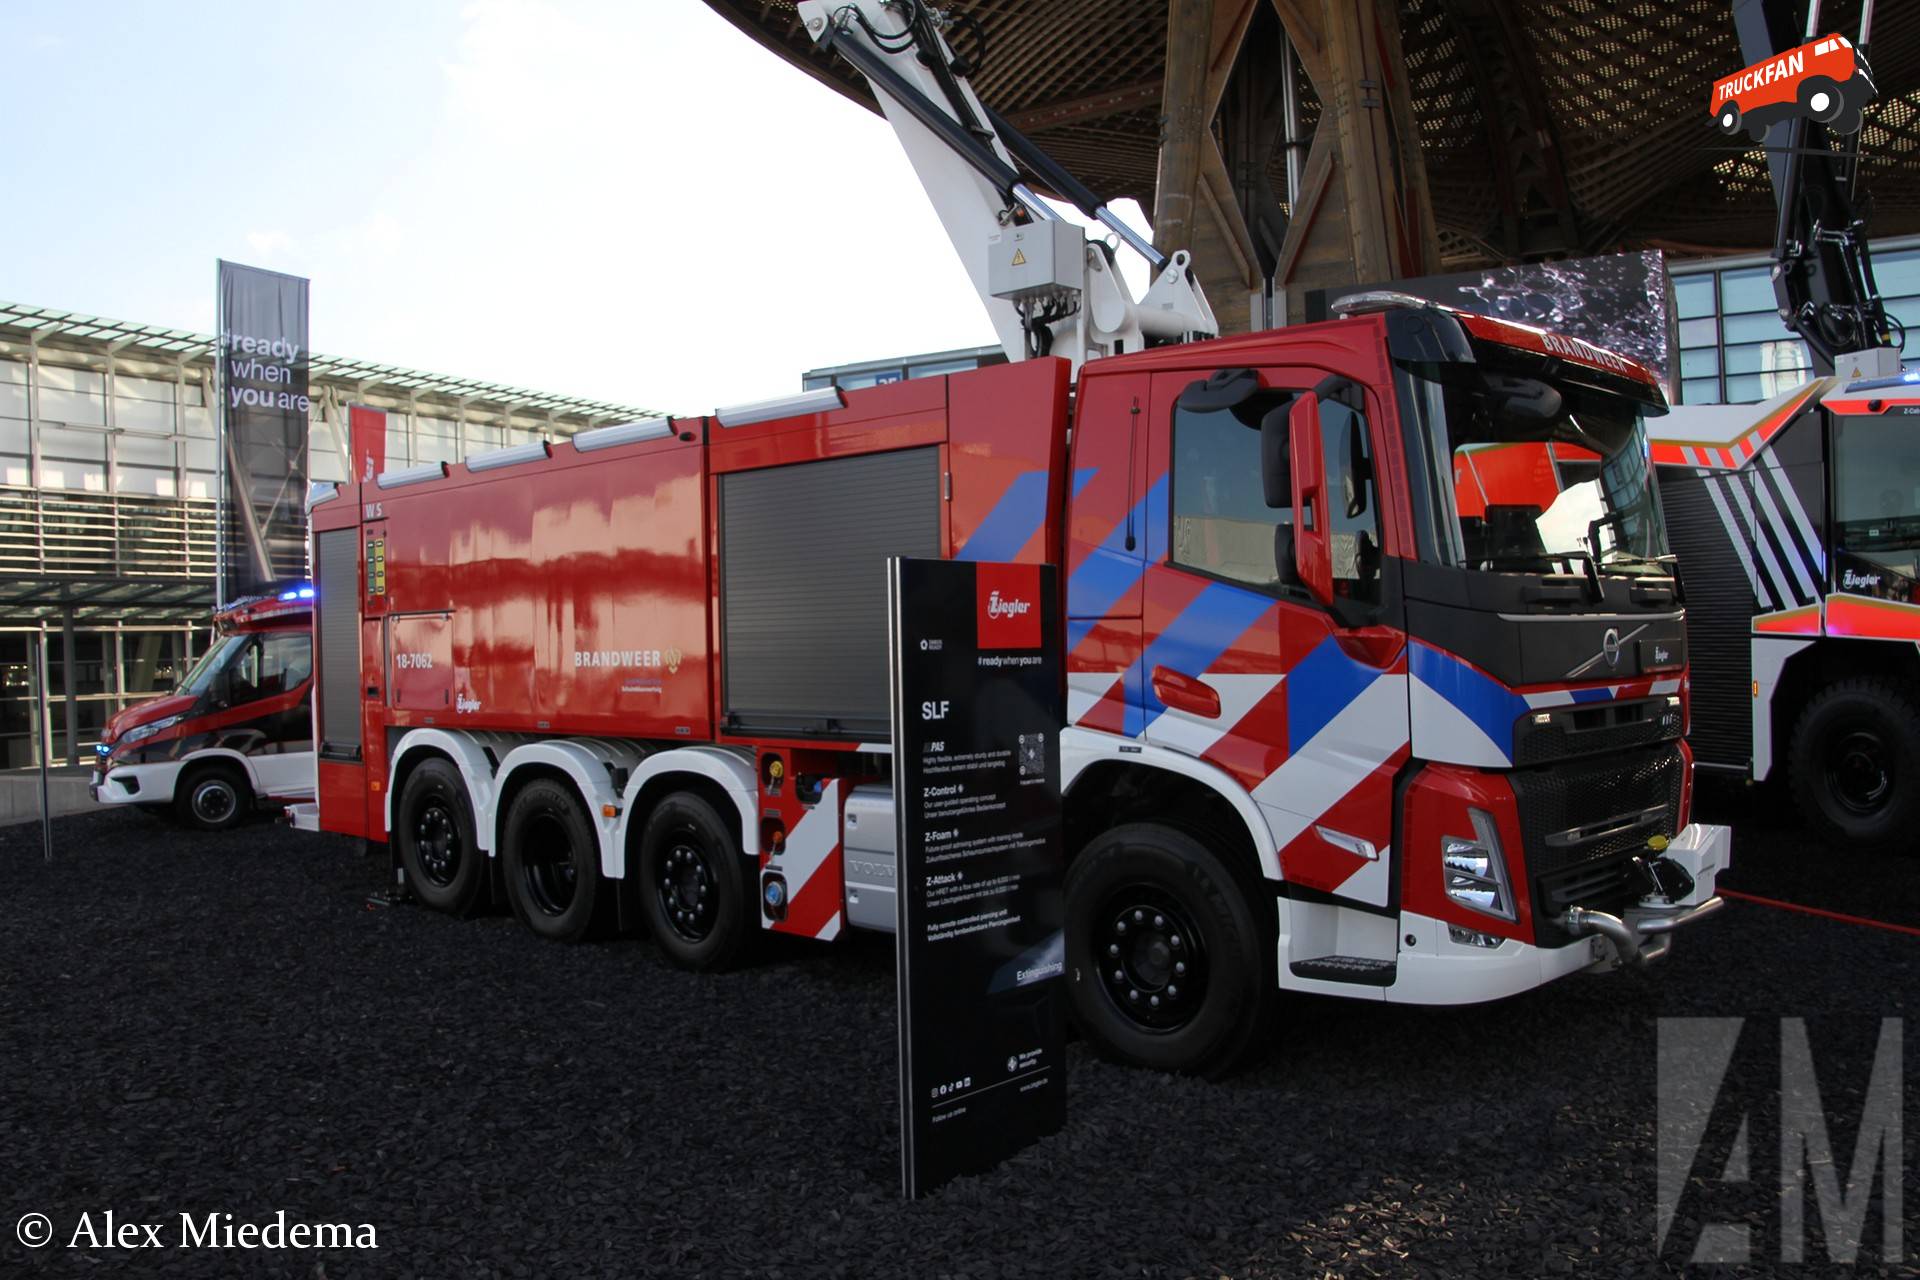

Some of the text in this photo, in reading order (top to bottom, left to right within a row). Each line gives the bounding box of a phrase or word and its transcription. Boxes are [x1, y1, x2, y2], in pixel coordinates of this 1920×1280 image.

[231, 358, 291, 384] when
[231, 386, 310, 412] you are
[1843, 569, 1881, 589] Ziegler
[987, 590, 1030, 620] Ziegler
[396, 653, 433, 669] 18-7062
[575, 650, 661, 667] BRANDWEER
[922, 701, 950, 720] SLF
[923, 784, 957, 798] Z-Control
[925, 831, 952, 842] Z-Foam
[848, 860, 896, 877] VOLV
